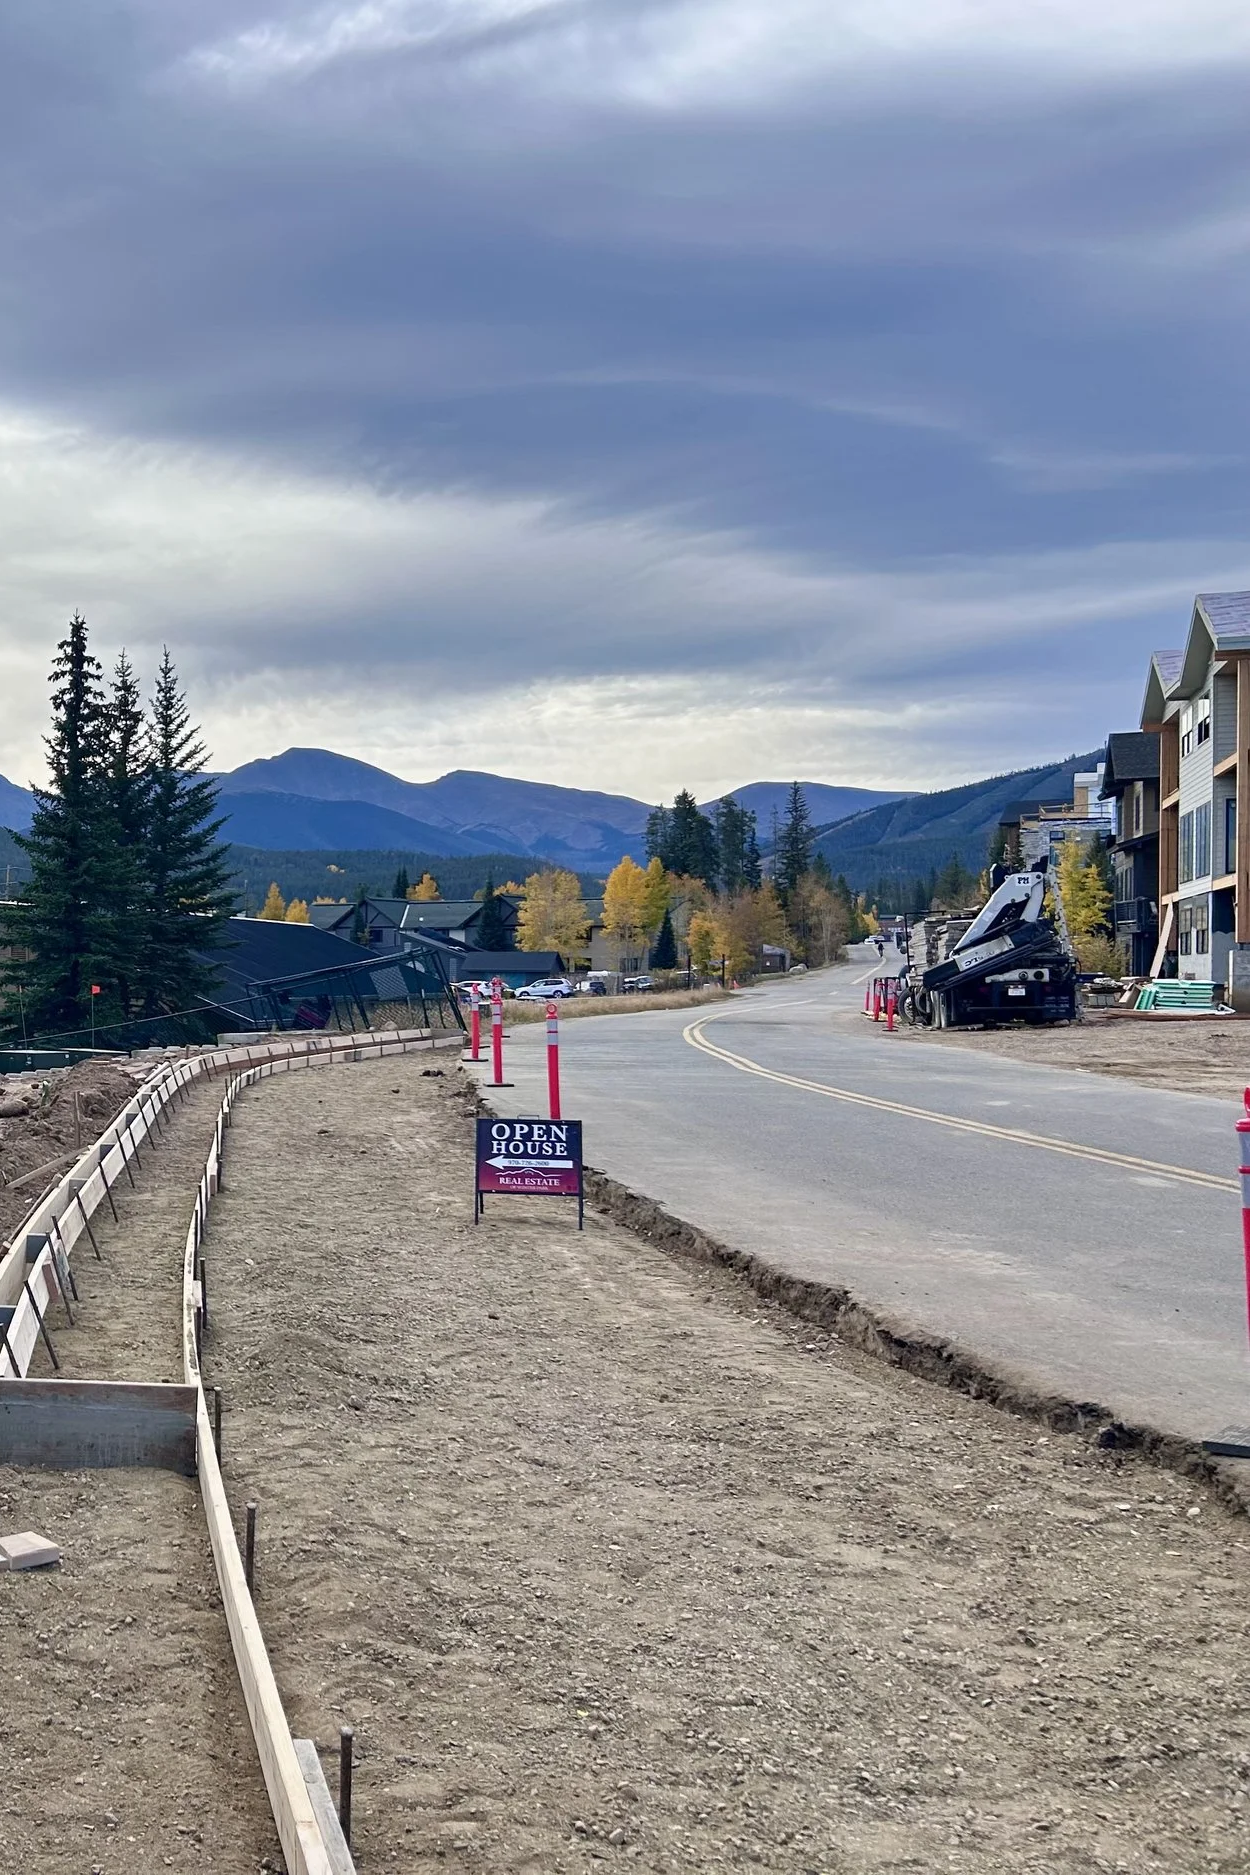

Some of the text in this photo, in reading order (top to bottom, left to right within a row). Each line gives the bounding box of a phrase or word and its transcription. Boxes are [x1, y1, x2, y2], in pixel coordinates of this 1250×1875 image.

[491, 1123, 569, 1142] OPEN
[491, 1140, 568, 1156] HOUSE
[499, 1177, 560, 1186] REAL ESTATE
